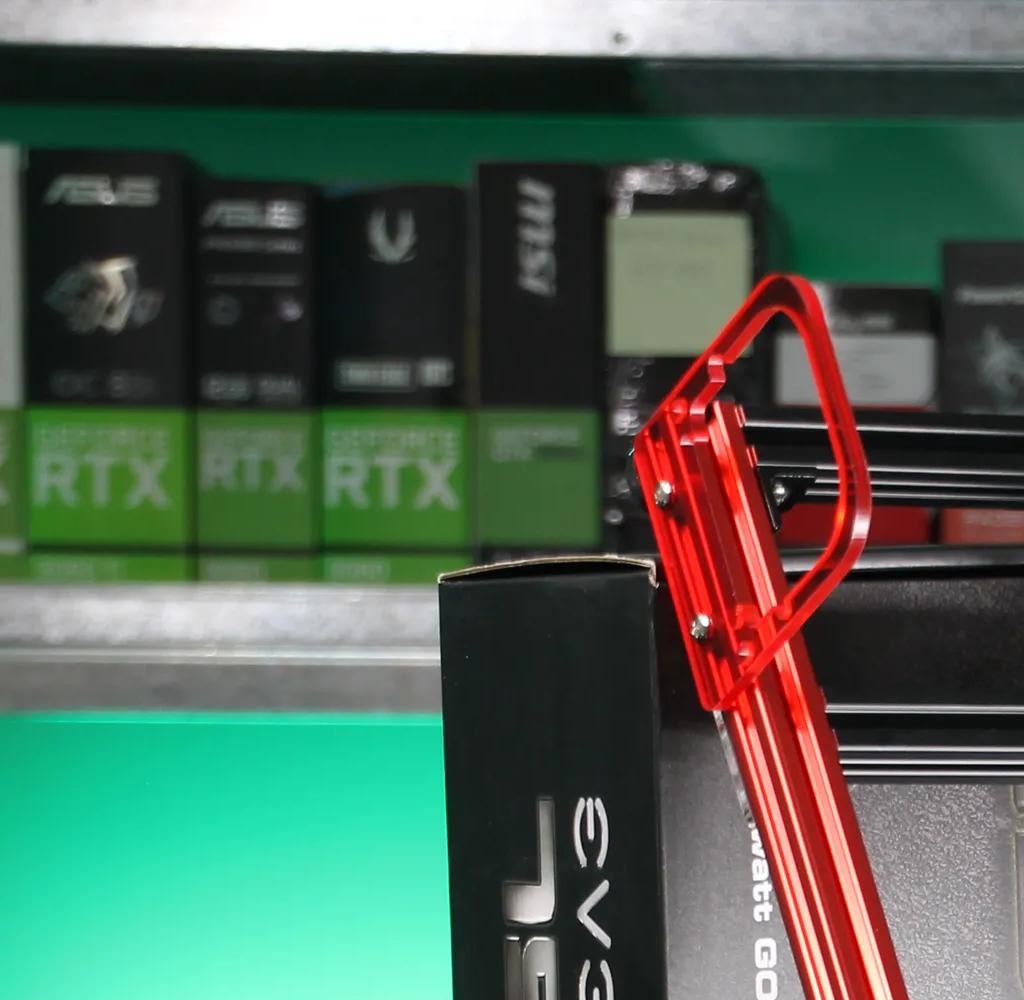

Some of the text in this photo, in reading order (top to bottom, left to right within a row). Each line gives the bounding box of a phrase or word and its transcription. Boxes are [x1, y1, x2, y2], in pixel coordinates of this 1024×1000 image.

[43, 173, 161, 207] ASUS
[516, 177, 557, 297] msi
[33, 454, 171, 509] RTX
[202, 450, 306, 493] RTX
[323, 455, 461, 511] RTX
